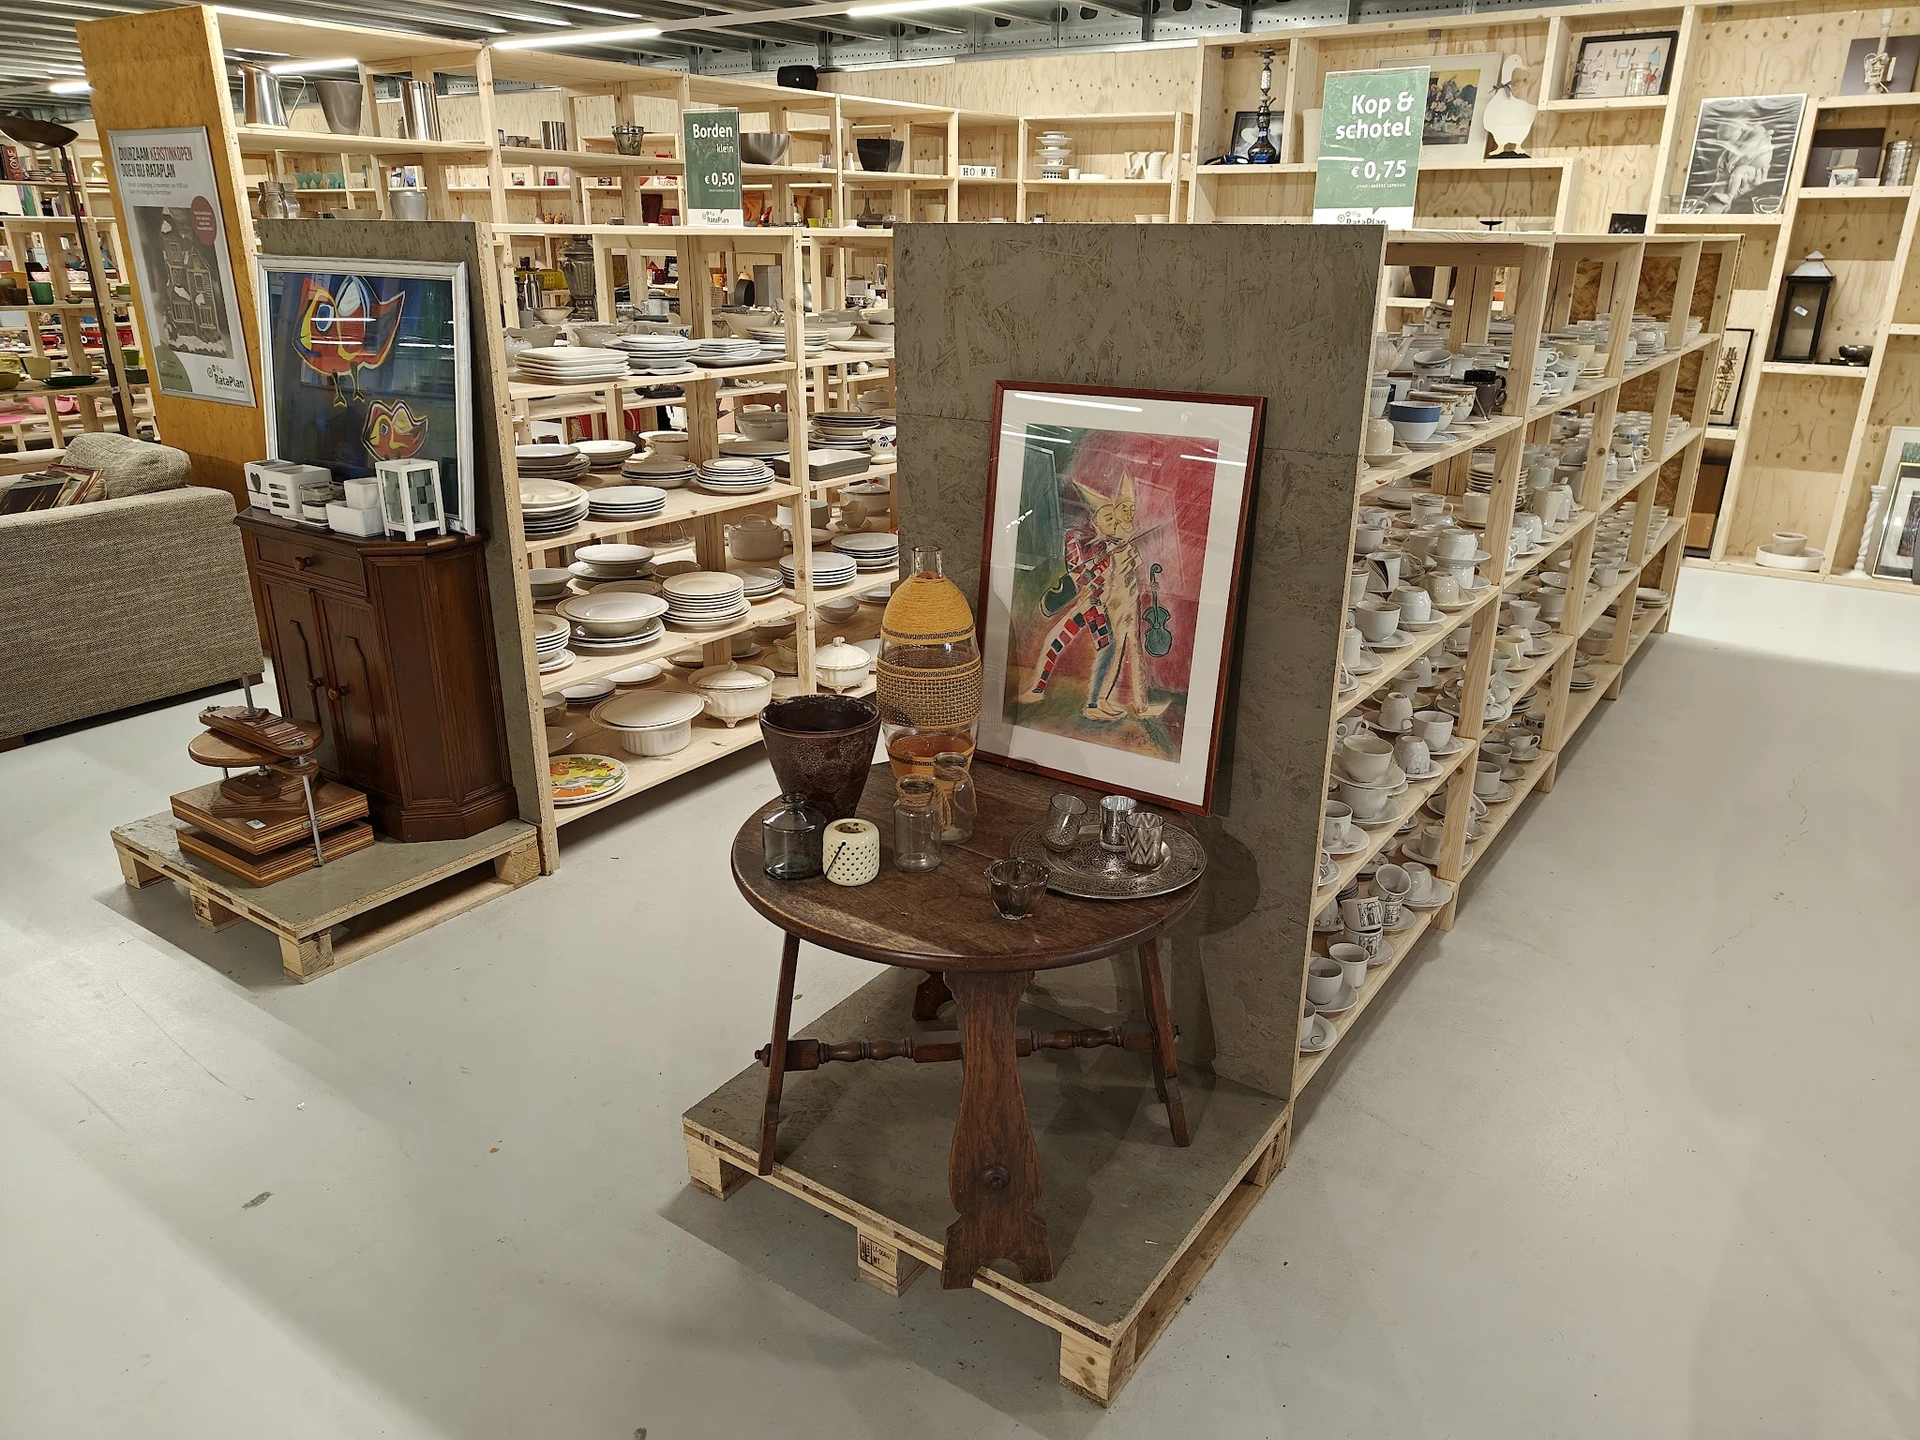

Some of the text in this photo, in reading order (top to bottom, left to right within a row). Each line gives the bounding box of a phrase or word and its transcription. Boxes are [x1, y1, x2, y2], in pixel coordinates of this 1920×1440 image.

[1351, 92, 1414, 119] Kop &
[692, 123, 733, 139] Borden
[1335, 116, 1411, 140] schotel
[118, 146, 193, 161] DUURZAAM KERSTINKOPEN
[716, 144, 734, 154] klein
[120, 163, 137, 178] DOEN
[145, 163, 176, 178] RATAPLAN
[1351, 160, 1406, 181] € 0,75
[704, 172, 735, 187] € 0,50
[214, 373, 245, 389] RataPlan
